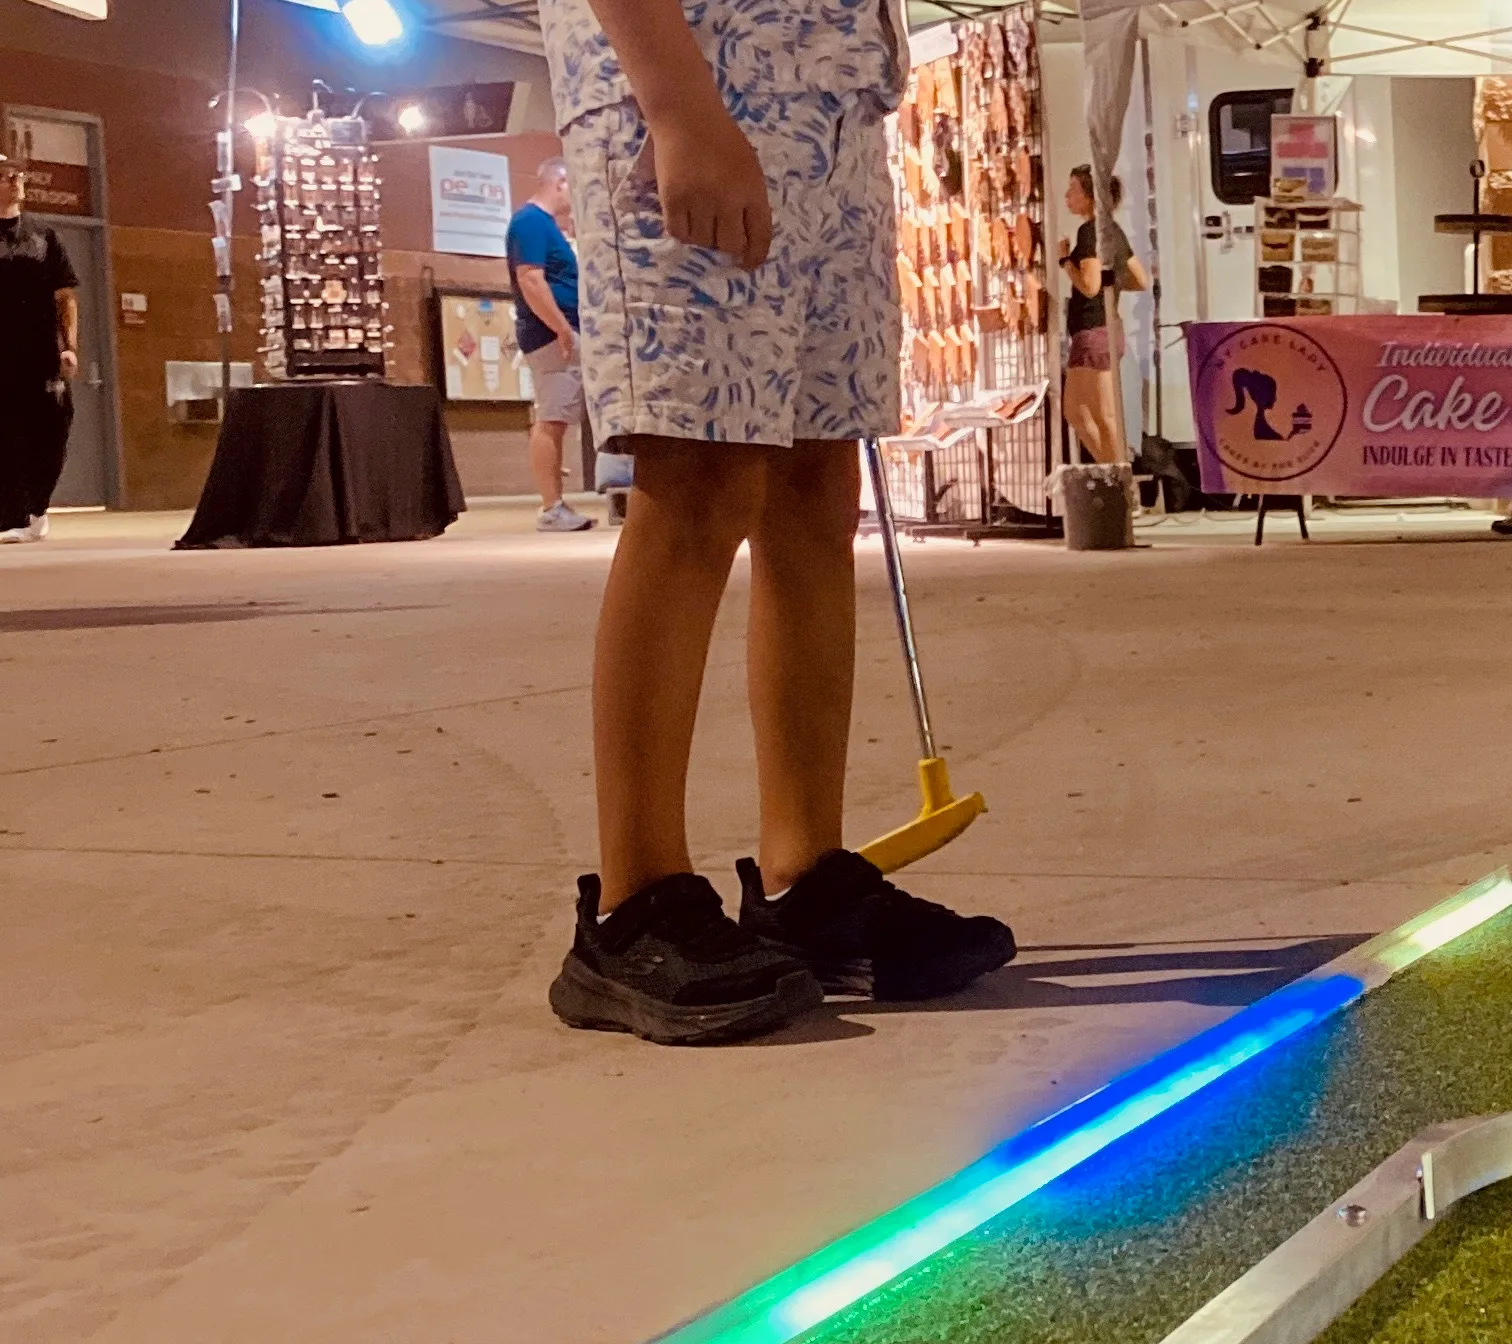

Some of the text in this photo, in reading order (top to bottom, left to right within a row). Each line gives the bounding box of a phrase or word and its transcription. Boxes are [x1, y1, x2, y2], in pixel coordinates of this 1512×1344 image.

[1362, 374, 1511, 433] Cake
[1363, 445, 1436, 467] INDULGE
[1441, 446, 1458, 467] IN
